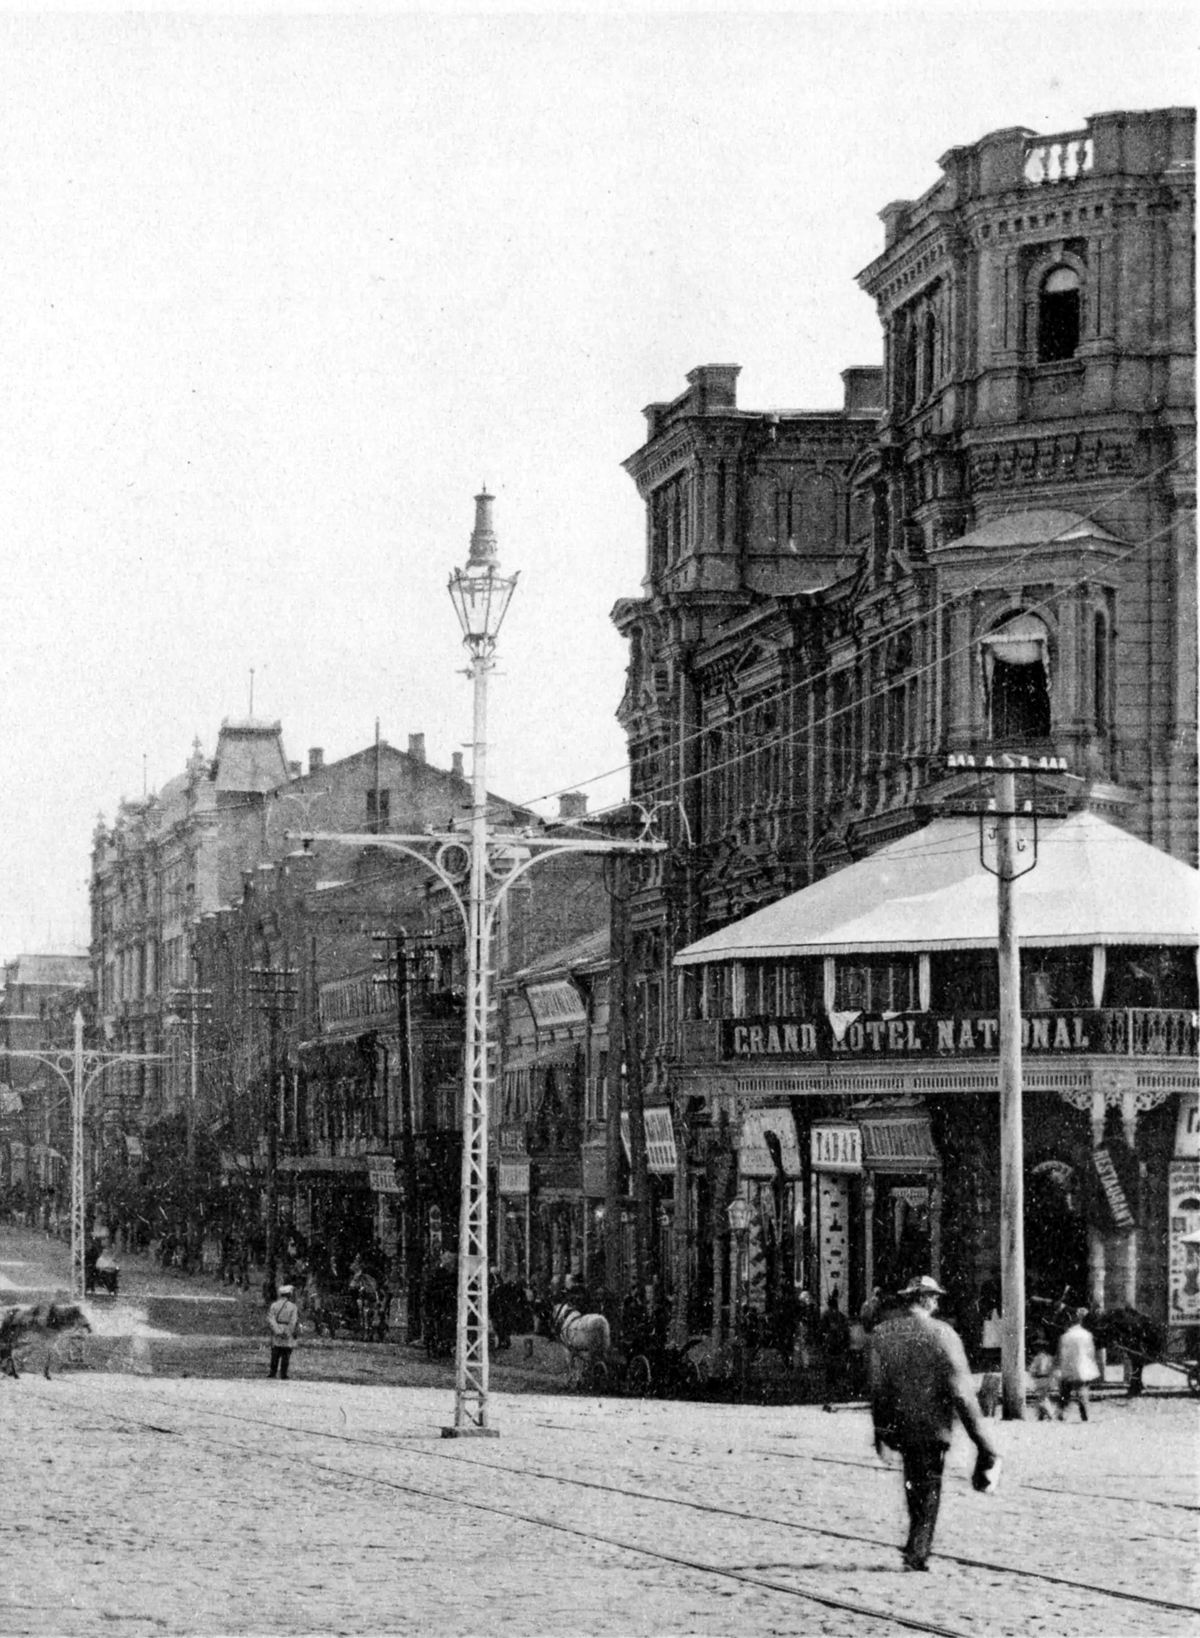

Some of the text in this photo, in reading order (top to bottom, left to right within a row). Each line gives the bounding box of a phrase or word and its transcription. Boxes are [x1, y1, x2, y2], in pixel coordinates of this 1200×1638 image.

[733, 1023, 817, 1053] GRAND
[937, 1017, 1089, 1049] NATONAL
[1092, 1149, 1136, 1228] RESTAURANT
